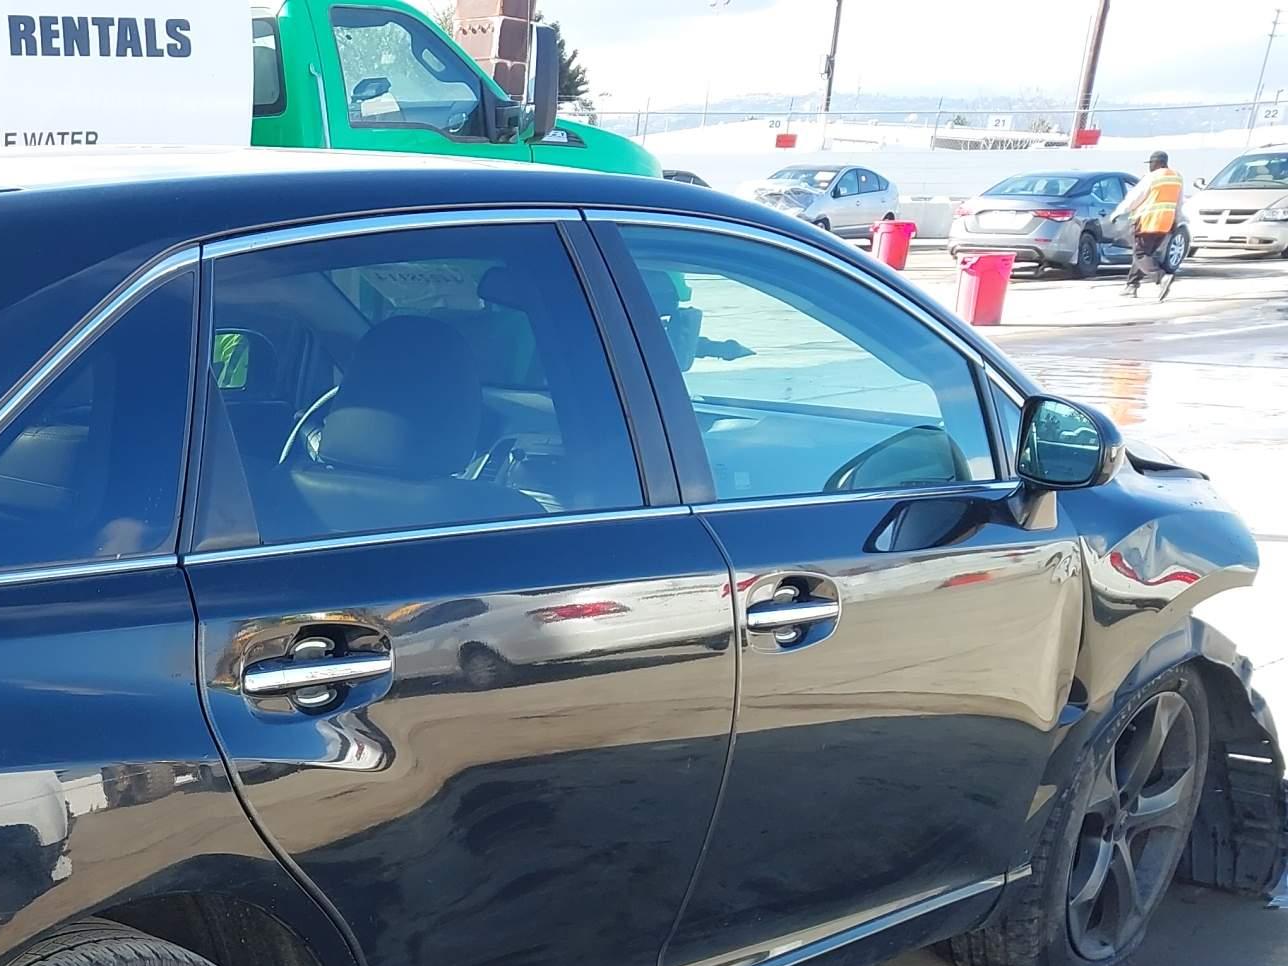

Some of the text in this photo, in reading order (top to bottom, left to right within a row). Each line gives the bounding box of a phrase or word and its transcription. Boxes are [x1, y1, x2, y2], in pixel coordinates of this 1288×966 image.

[8, 15, 192, 57] RENTALS
[1264, 109, 1279, 118] 22
[769, 120, 781, 128] 20
[994, 119, 1006, 127] 21
[23, 131, 99, 147] WATER
